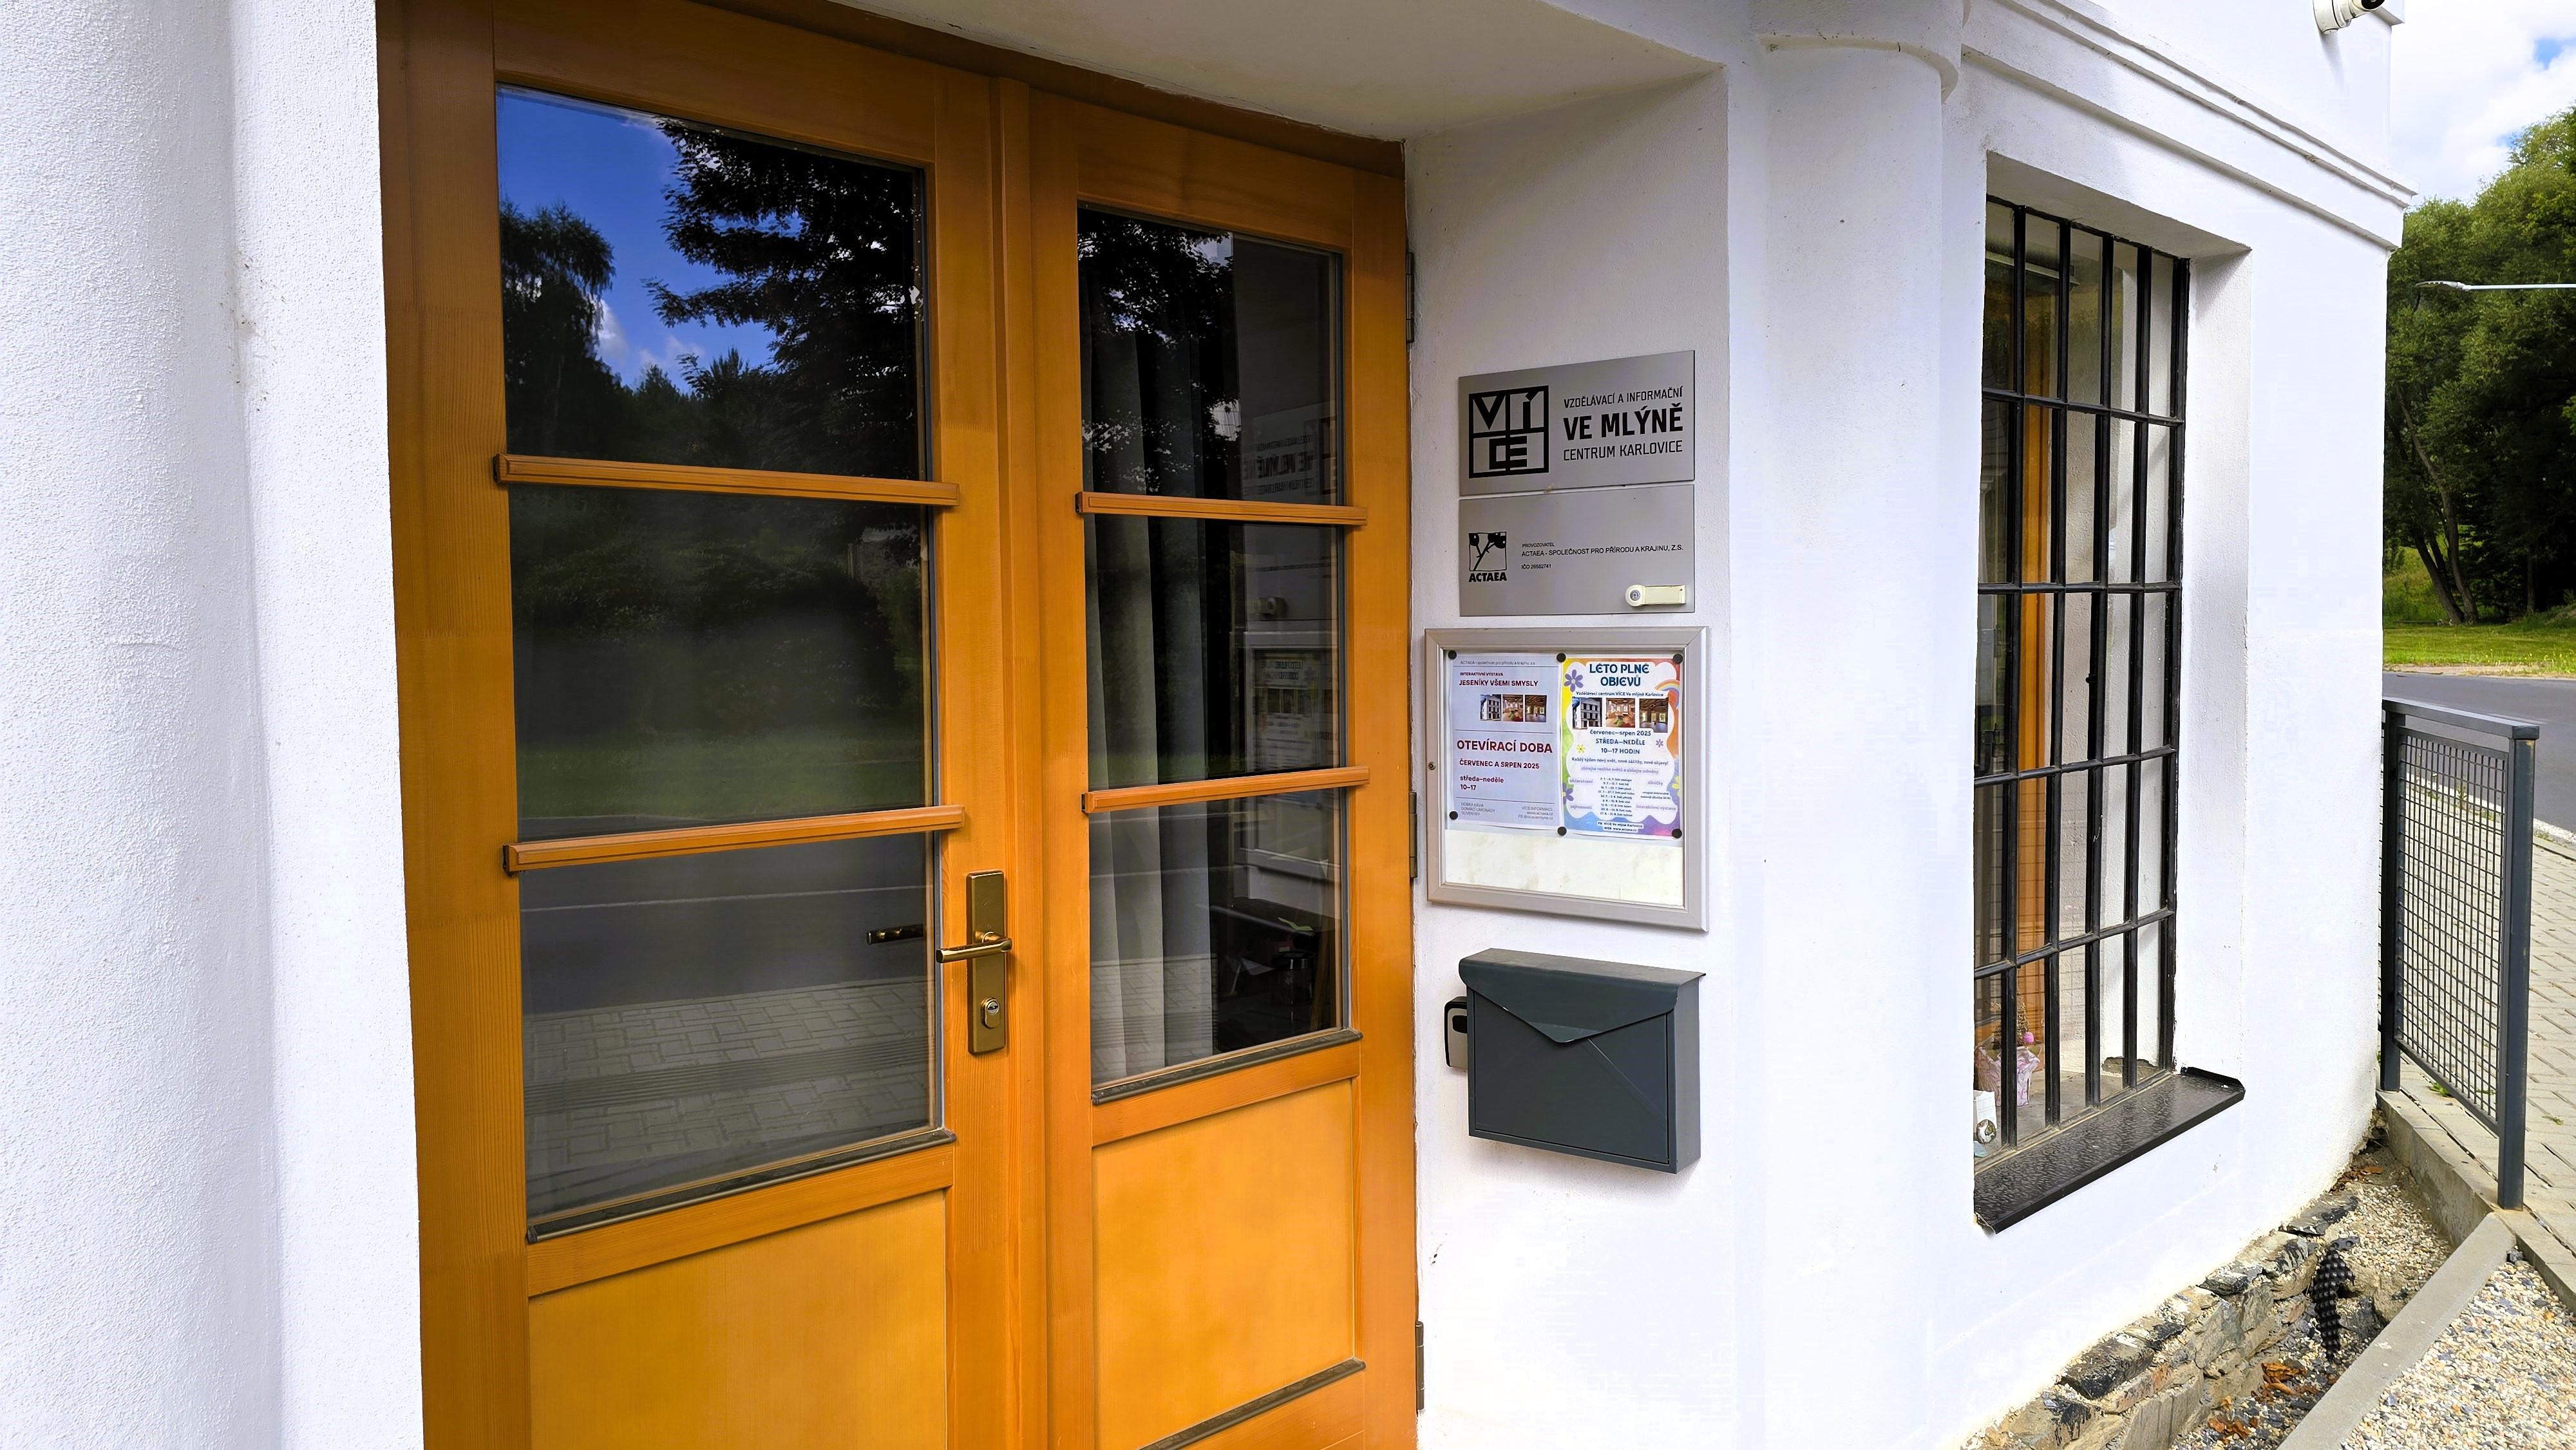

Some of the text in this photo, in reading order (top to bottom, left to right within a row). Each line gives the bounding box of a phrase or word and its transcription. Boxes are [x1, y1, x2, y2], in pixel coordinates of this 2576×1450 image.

[1564, 386, 1683, 408] VZDĚLÁVACÍ A INFORMAČNÍ
[1563, 402, 1683, 440] VE MLÝNĚ
[1564, 440, 1683, 461] CENTRUM KARLOVICE
[1549, 547, 1589, 556] SPOLEČNOST
[1605, 545, 1634, 554] PŘÍRODU
[1468, 572, 1507, 583] ACTAEA
[1589, 663, 1649, 674] LÉTO PLNÉ
[1459, 678, 1489, 686] JESENÍKY
[1600, 675, 1641, 687] OBJEVŮ
[1457, 738, 1553, 753] OTEVÍRACÍ DOBA
[1459, 758, 1493, 767] ČERVENEC
